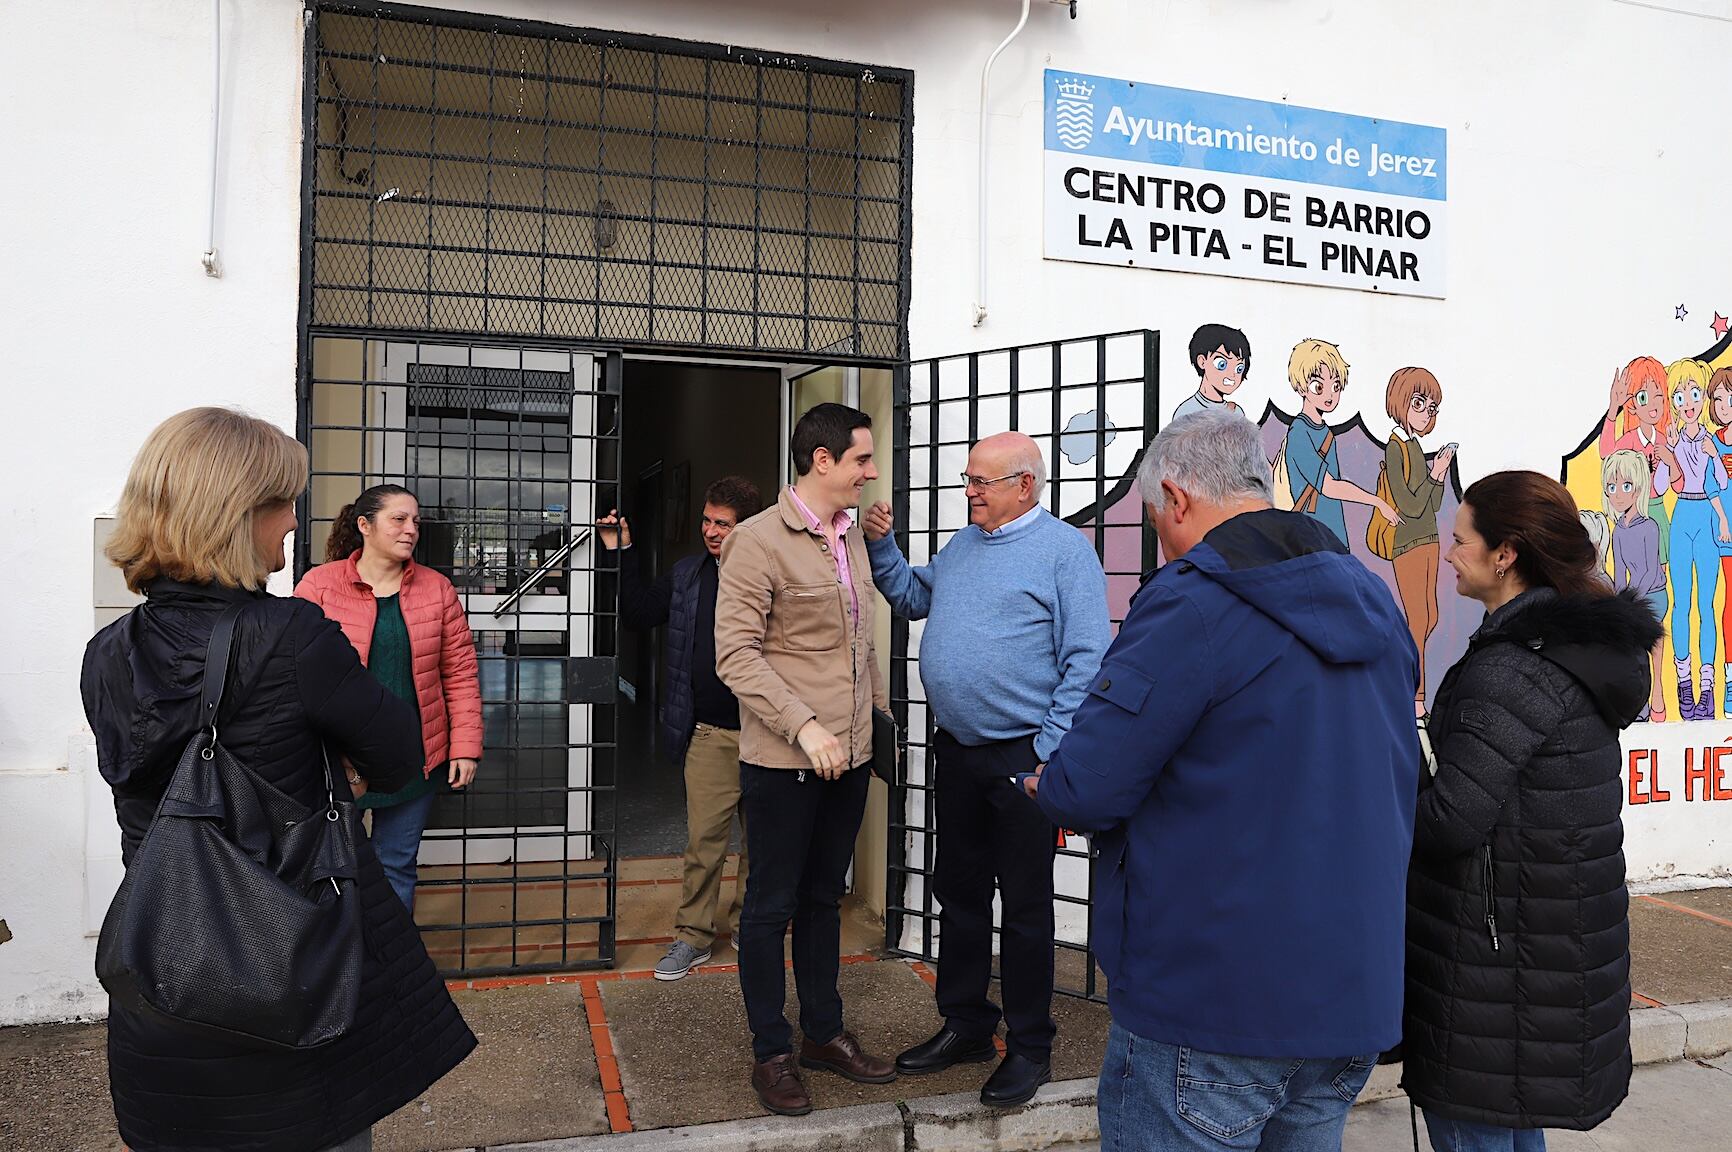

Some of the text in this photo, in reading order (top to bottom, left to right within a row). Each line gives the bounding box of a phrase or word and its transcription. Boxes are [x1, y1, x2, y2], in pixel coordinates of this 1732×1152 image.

[1103, 106, 1437, 178] Ayuntamiento de Jerez
[1063, 166, 1432, 240] CENTRO DE BARRIO
[1078, 213, 1133, 251] LA
[1149, 222, 1231, 260] PITA
[1263, 234, 1307, 269] EL
[1321, 242, 1420, 282] PINAR
[1629, 749, 1670, 805] EL
